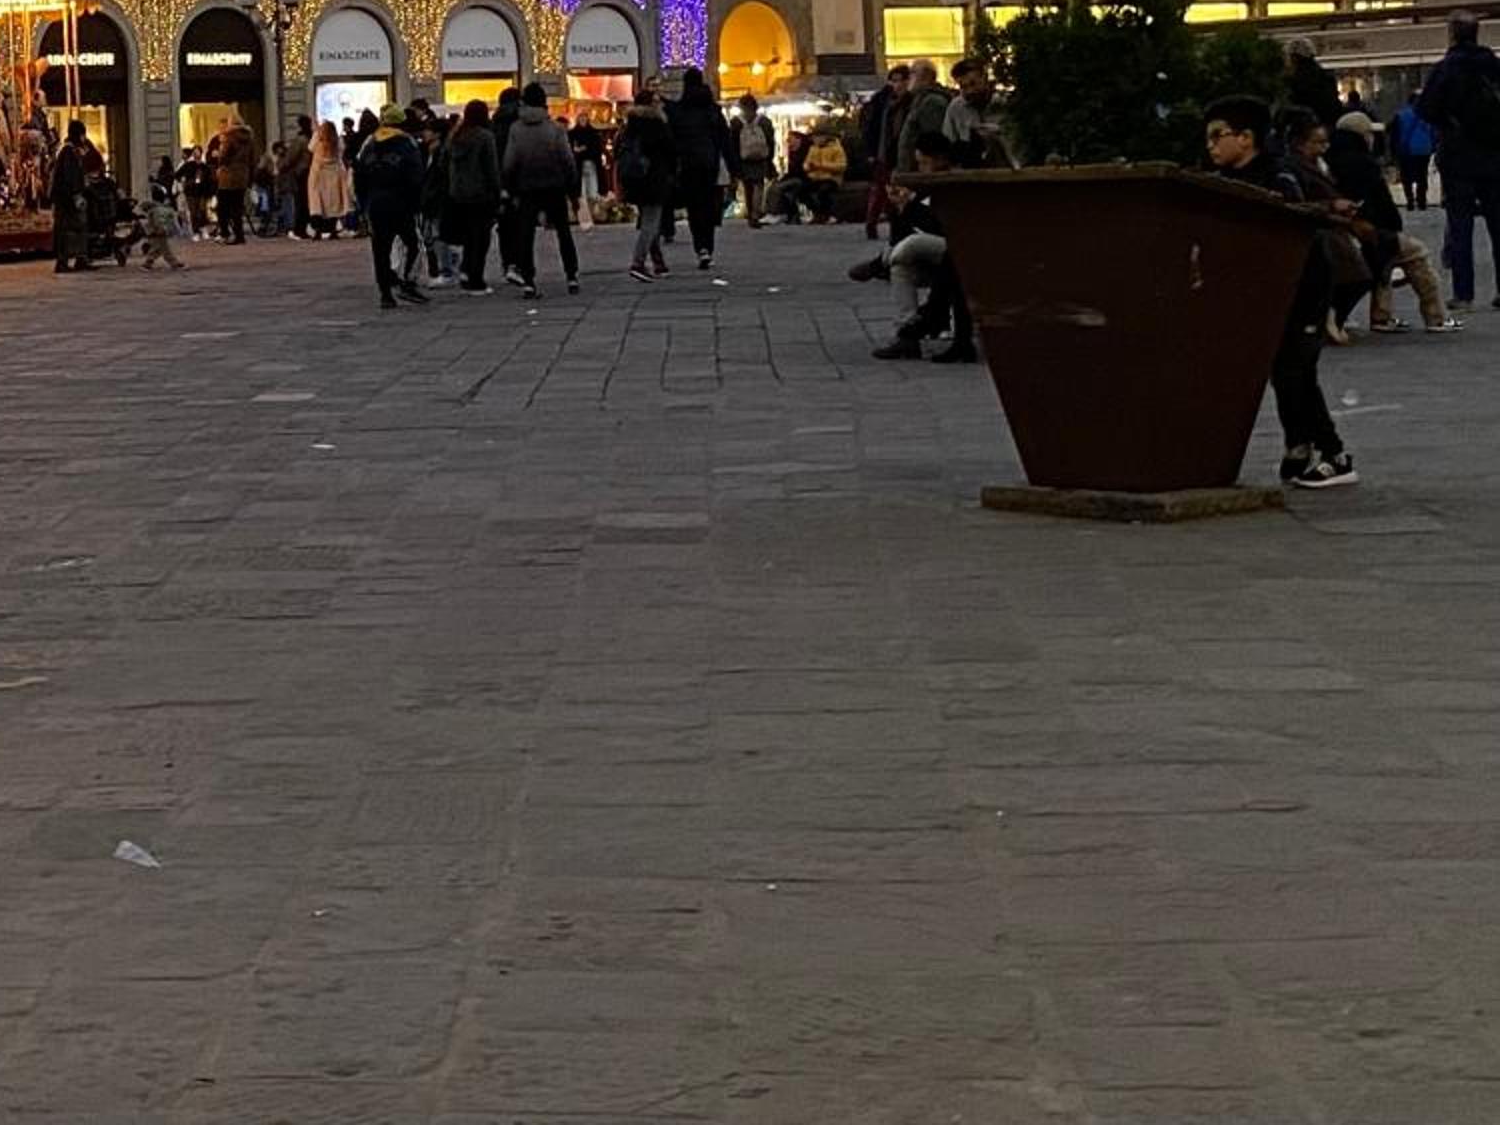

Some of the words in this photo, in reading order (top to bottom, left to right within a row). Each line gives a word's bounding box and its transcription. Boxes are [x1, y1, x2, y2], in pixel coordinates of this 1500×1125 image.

[447, 47, 506, 58] RINASCENTE
[571, 44, 629, 54] RINASCENTE
[46, 52, 115, 66] RINACENTE
[186, 52, 252, 66] RINASCENTE
[319, 50, 381, 60] RINASCENTE
